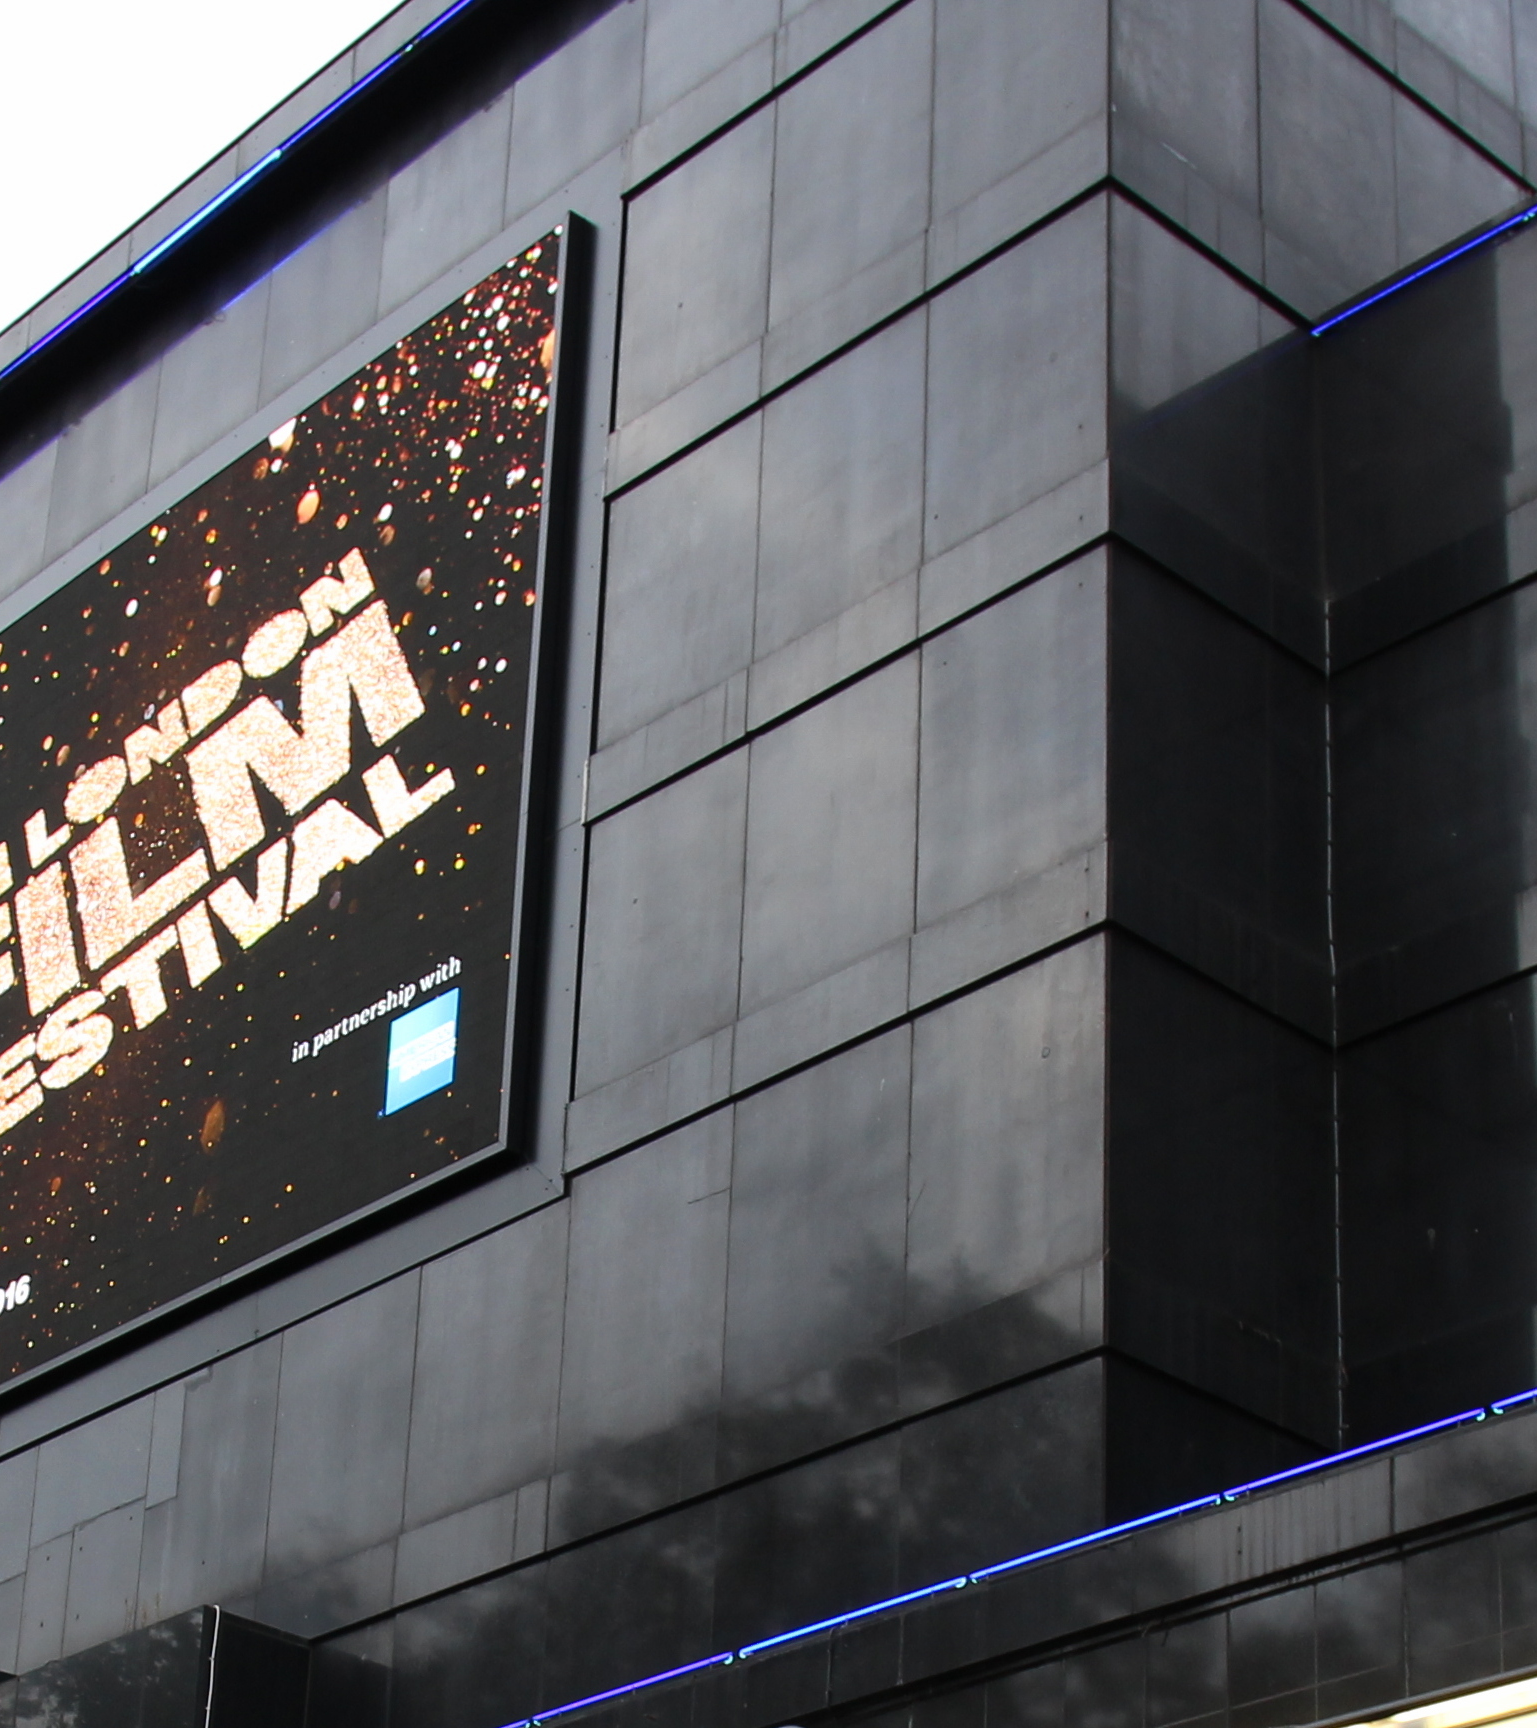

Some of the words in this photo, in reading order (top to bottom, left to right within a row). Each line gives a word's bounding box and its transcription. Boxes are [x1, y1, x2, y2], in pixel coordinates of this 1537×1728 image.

[25, 545, 377, 870] LONDON
[291, 1040, 310, 1063] in
[312, 982, 417, 1057] partnership
[419, 955, 462, 993] with
